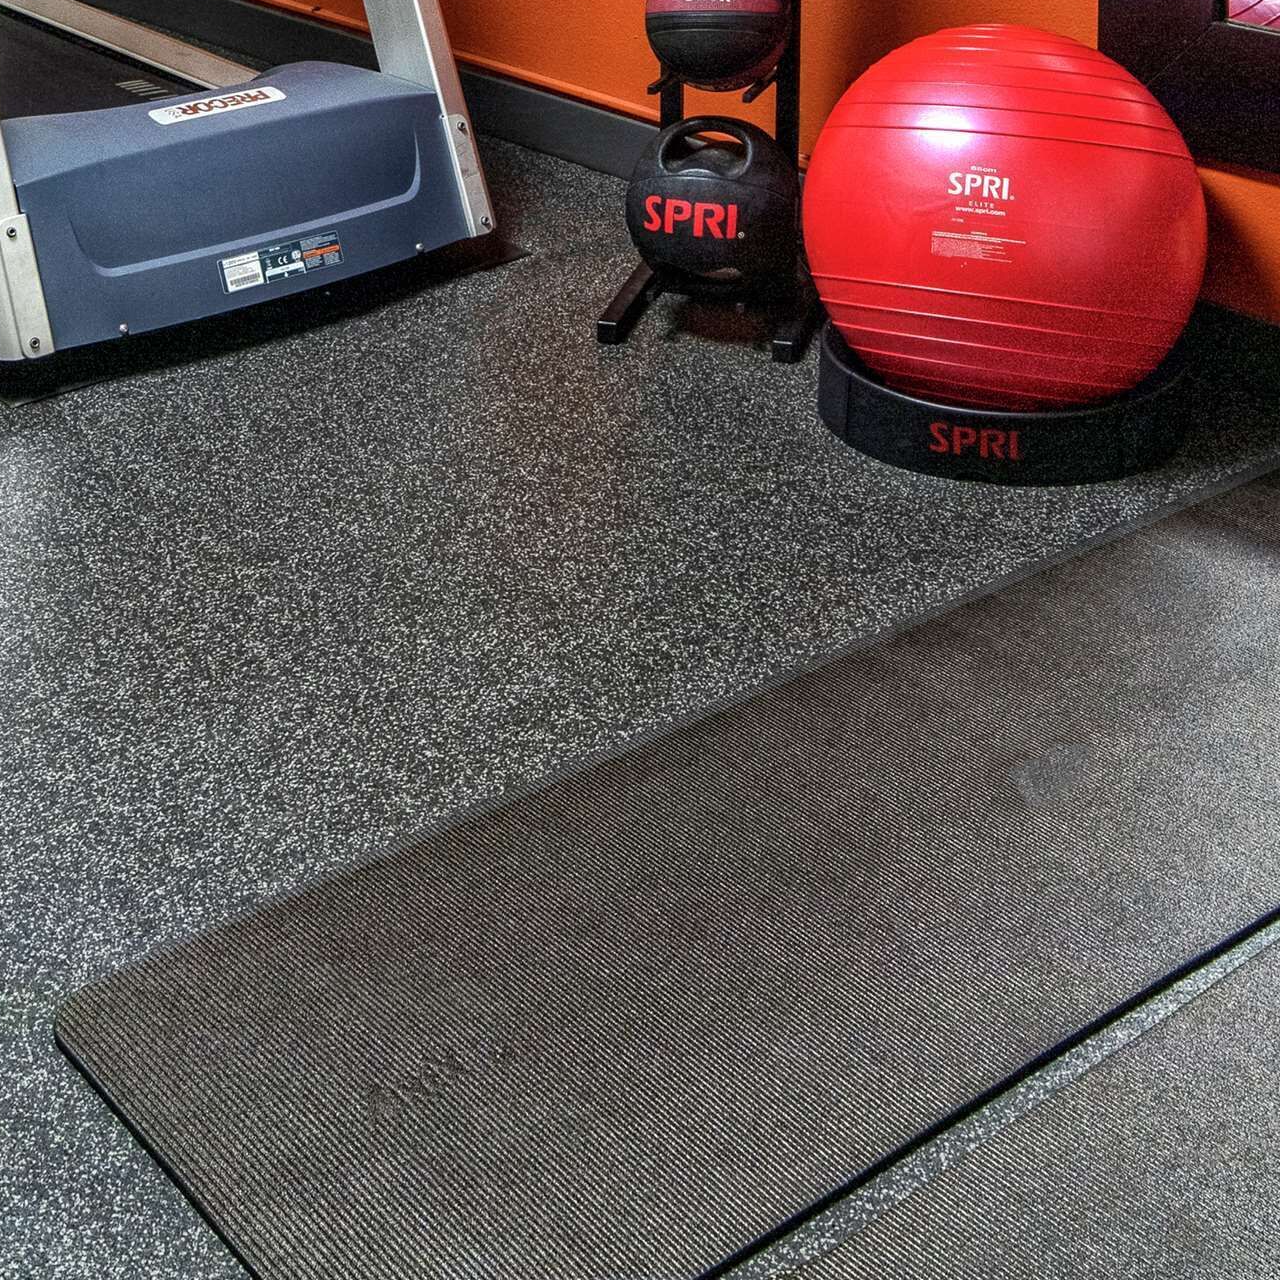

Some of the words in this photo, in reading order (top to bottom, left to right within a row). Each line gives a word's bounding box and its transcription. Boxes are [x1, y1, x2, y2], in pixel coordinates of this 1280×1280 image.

[177, 89, 272, 116] PRECOR
[947, 171, 1010, 201] SPRI
[642, 194, 739, 241] SPRI
[928, 421, 1020, 461] SPRI
